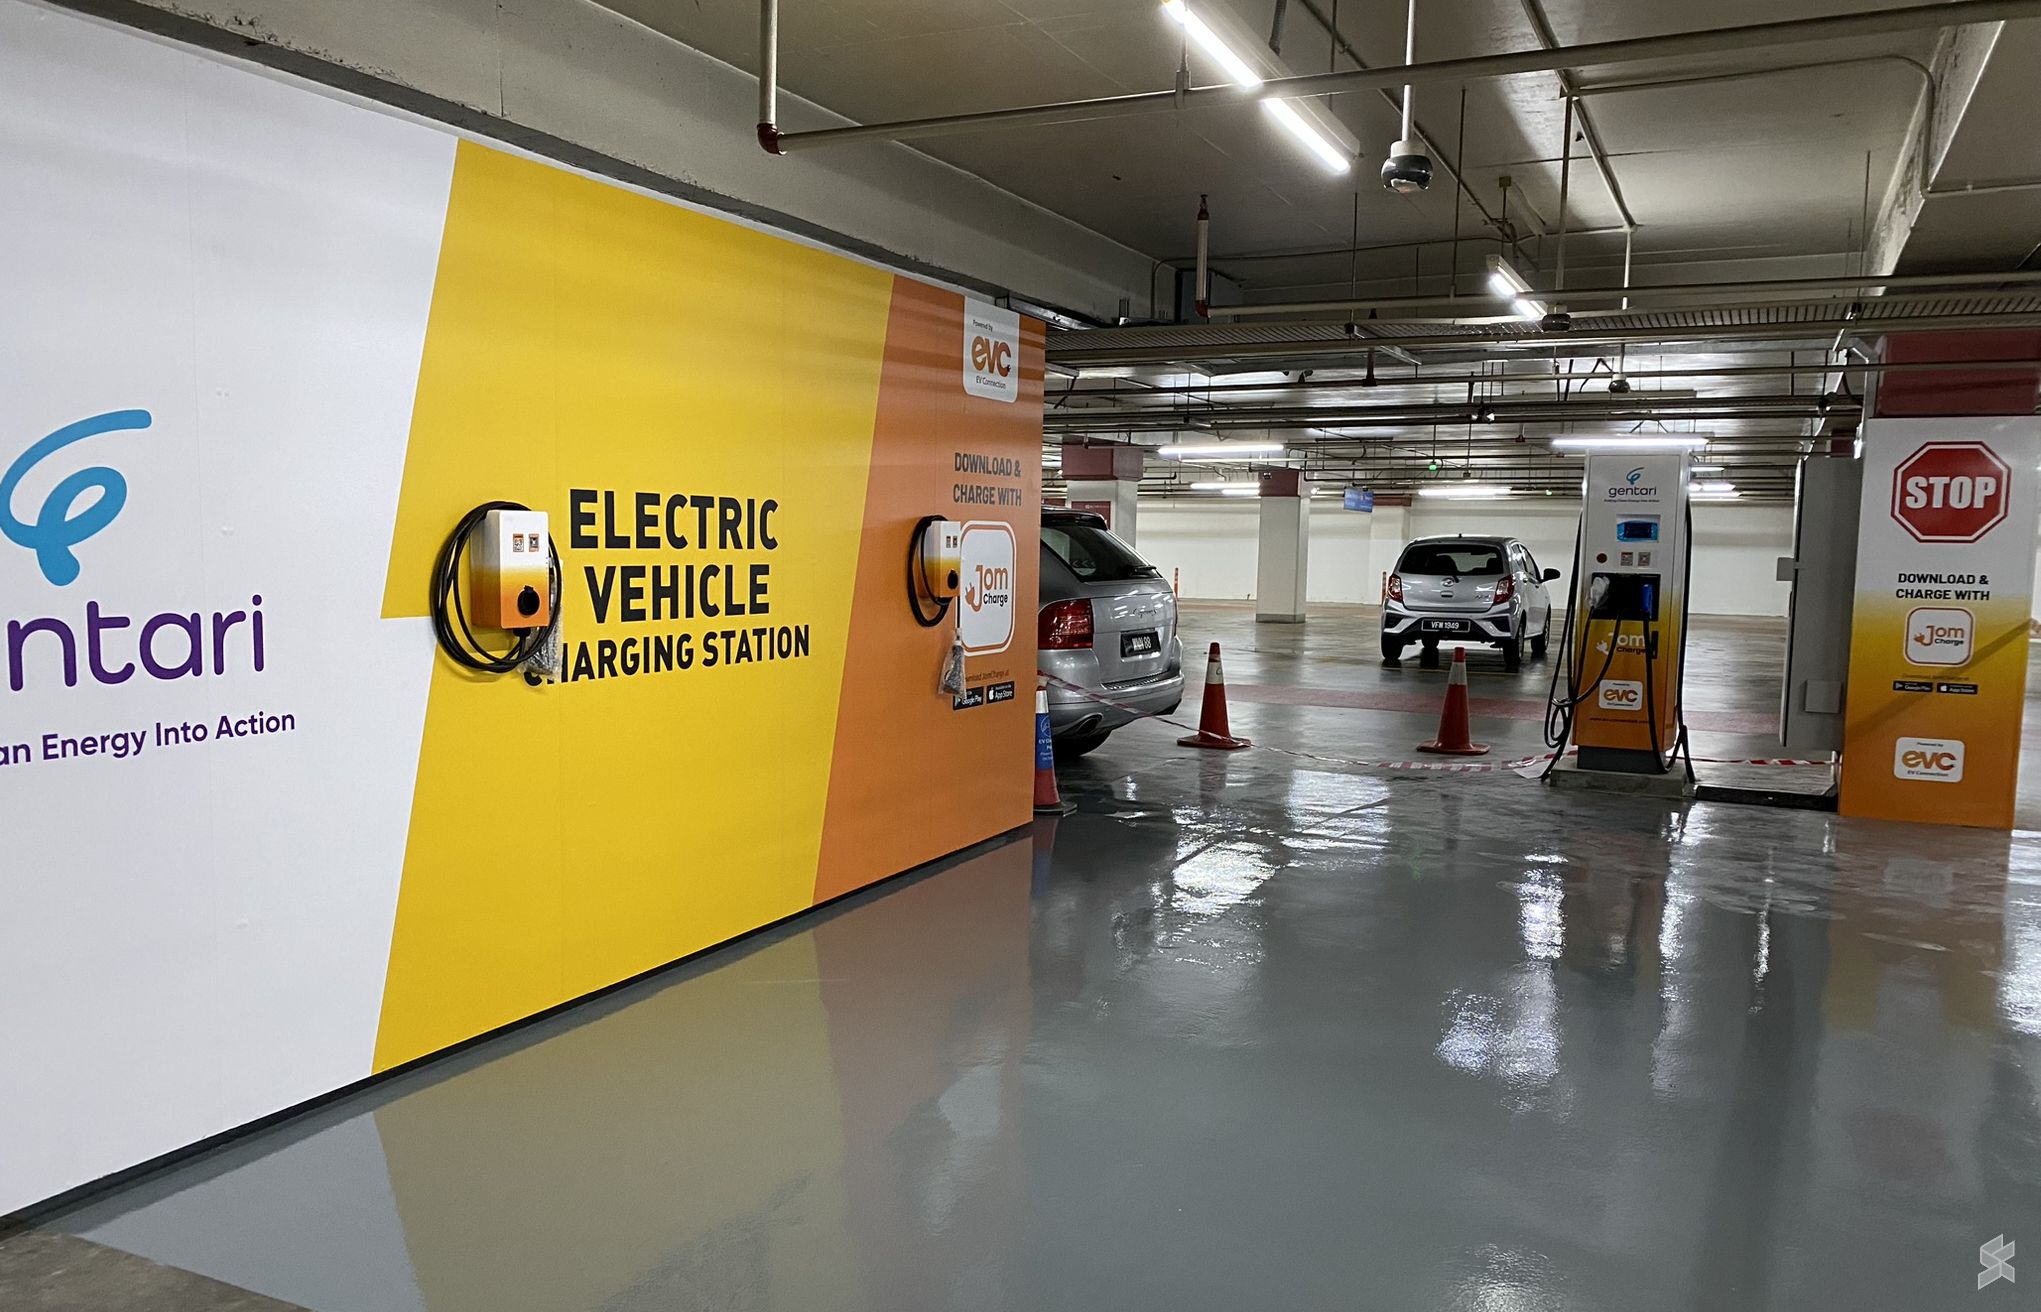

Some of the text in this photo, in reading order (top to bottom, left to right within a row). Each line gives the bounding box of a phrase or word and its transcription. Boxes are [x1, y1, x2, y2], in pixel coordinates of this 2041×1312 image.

[971, 336, 1011, 377] evc
[954, 452, 1021, 477] DOWNLOAD &
[953, 483, 1022, 507] CHARGE WITH
[1608, 486, 1657, 498] gentari
[1905, 476, 1996, 510] STOP
[570, 488, 779, 550] ELECTRIC
[1898, 573, 1989, 585] DOWNLOAD &
[584, 563, 770, 624] VEHICLE
[983, 593, 1008, 607] Charge
[1896, 588, 1990, 601] CHARGE WITH
[702, 624, 810, 668] STATION
[1934, 638, 1964, 647] Charge
[42, 726, 147, 761] Energy
[155, 721, 208, 748] Into
[215, 711, 296, 740] Action
[1902, 750, 1956, 771] evc
